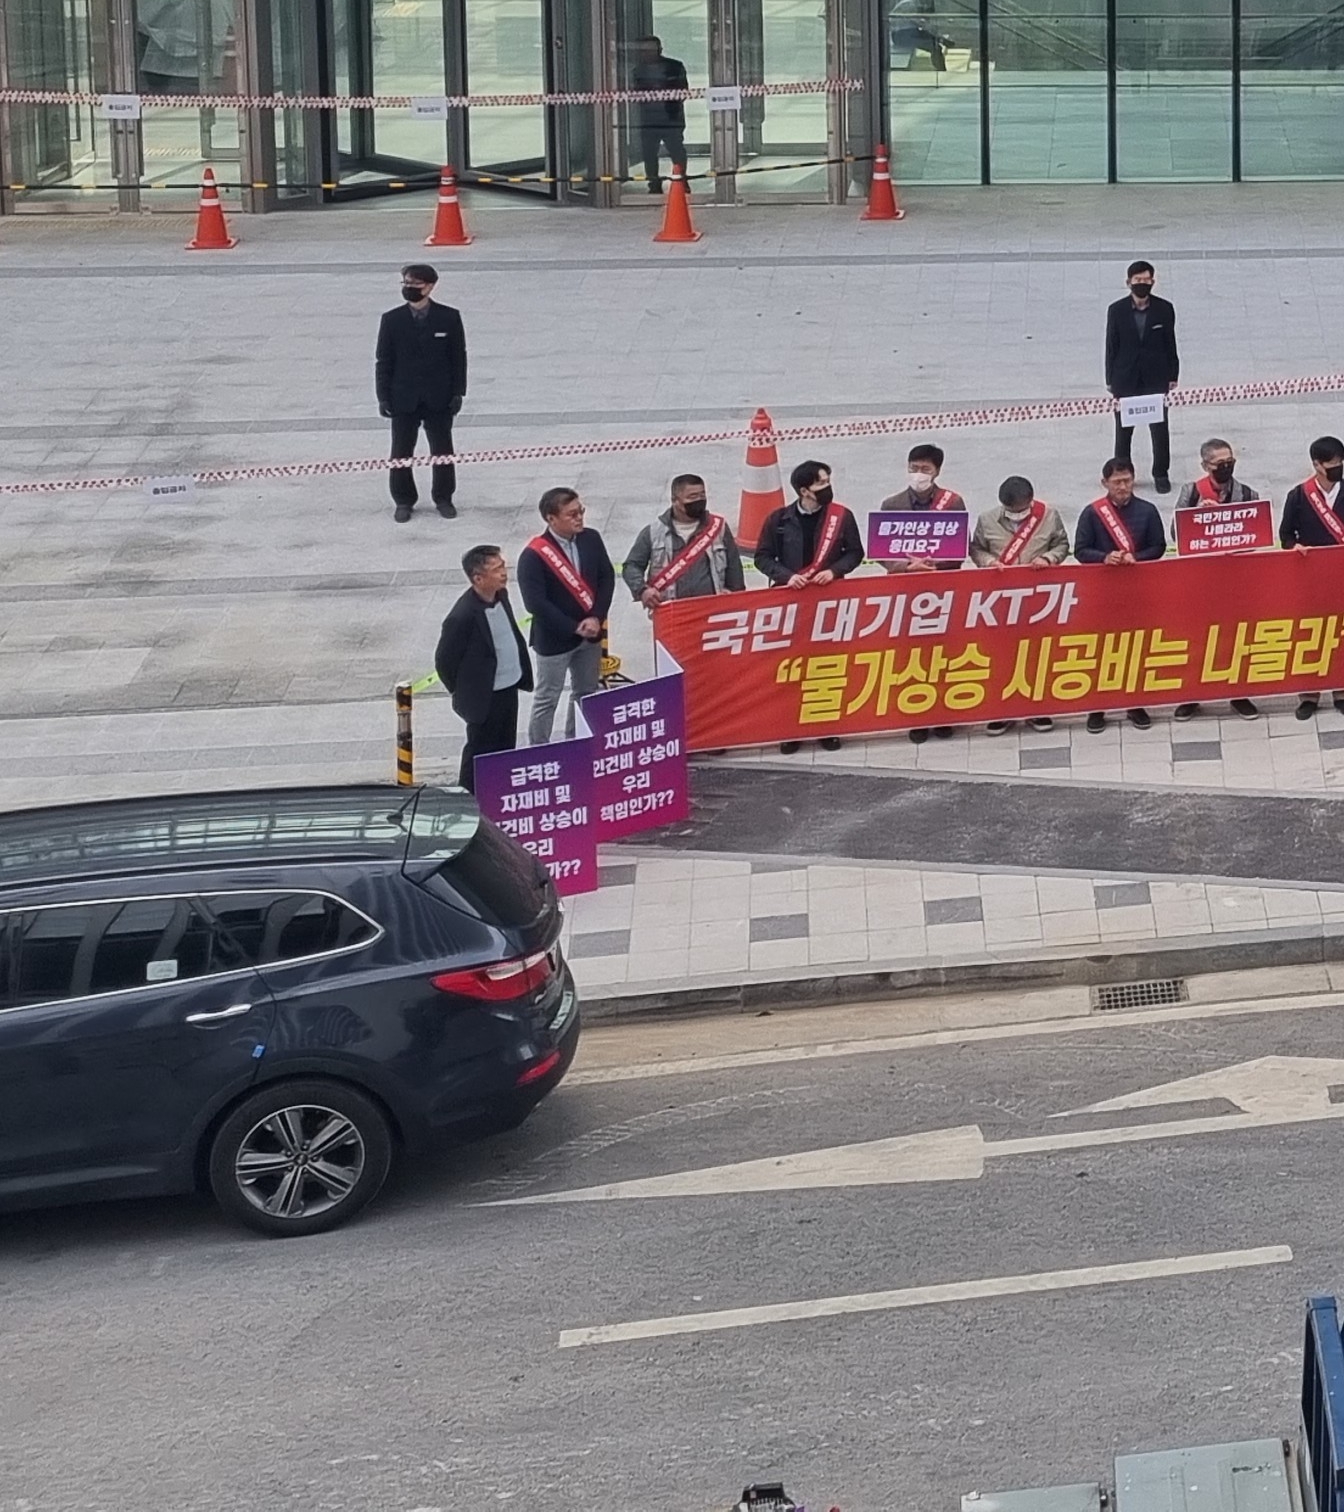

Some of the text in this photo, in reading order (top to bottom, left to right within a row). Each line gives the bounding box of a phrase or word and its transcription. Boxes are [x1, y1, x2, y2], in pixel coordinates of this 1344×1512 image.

[878, 521, 959, 536] 물가인상 협상
[1192, 507, 1258, 524] 국민기업 KT가
[1204, 522, 1244, 536] 나몰라라
[1190, 534, 1256, 550] 하는 기업인가?
[702, 582, 1079, 655] 국민 대기업 KT가
[776, 642, 991, 725] “물가상승
[1001, 628, 1189, 701] 시공비는
[612, 698, 656, 725] 급격한
[604, 719, 665, 750] 자재비 및
[593, 739, 680, 778] 인건비 상승이
[510, 761, 561, 787] 급격한
[622, 771, 650, 794] 우리
[500, 784, 572, 814] 자재비 및
[600, 789, 675, 823] 책임인가??
[494, 807, 587, 838] 건비 상승이
